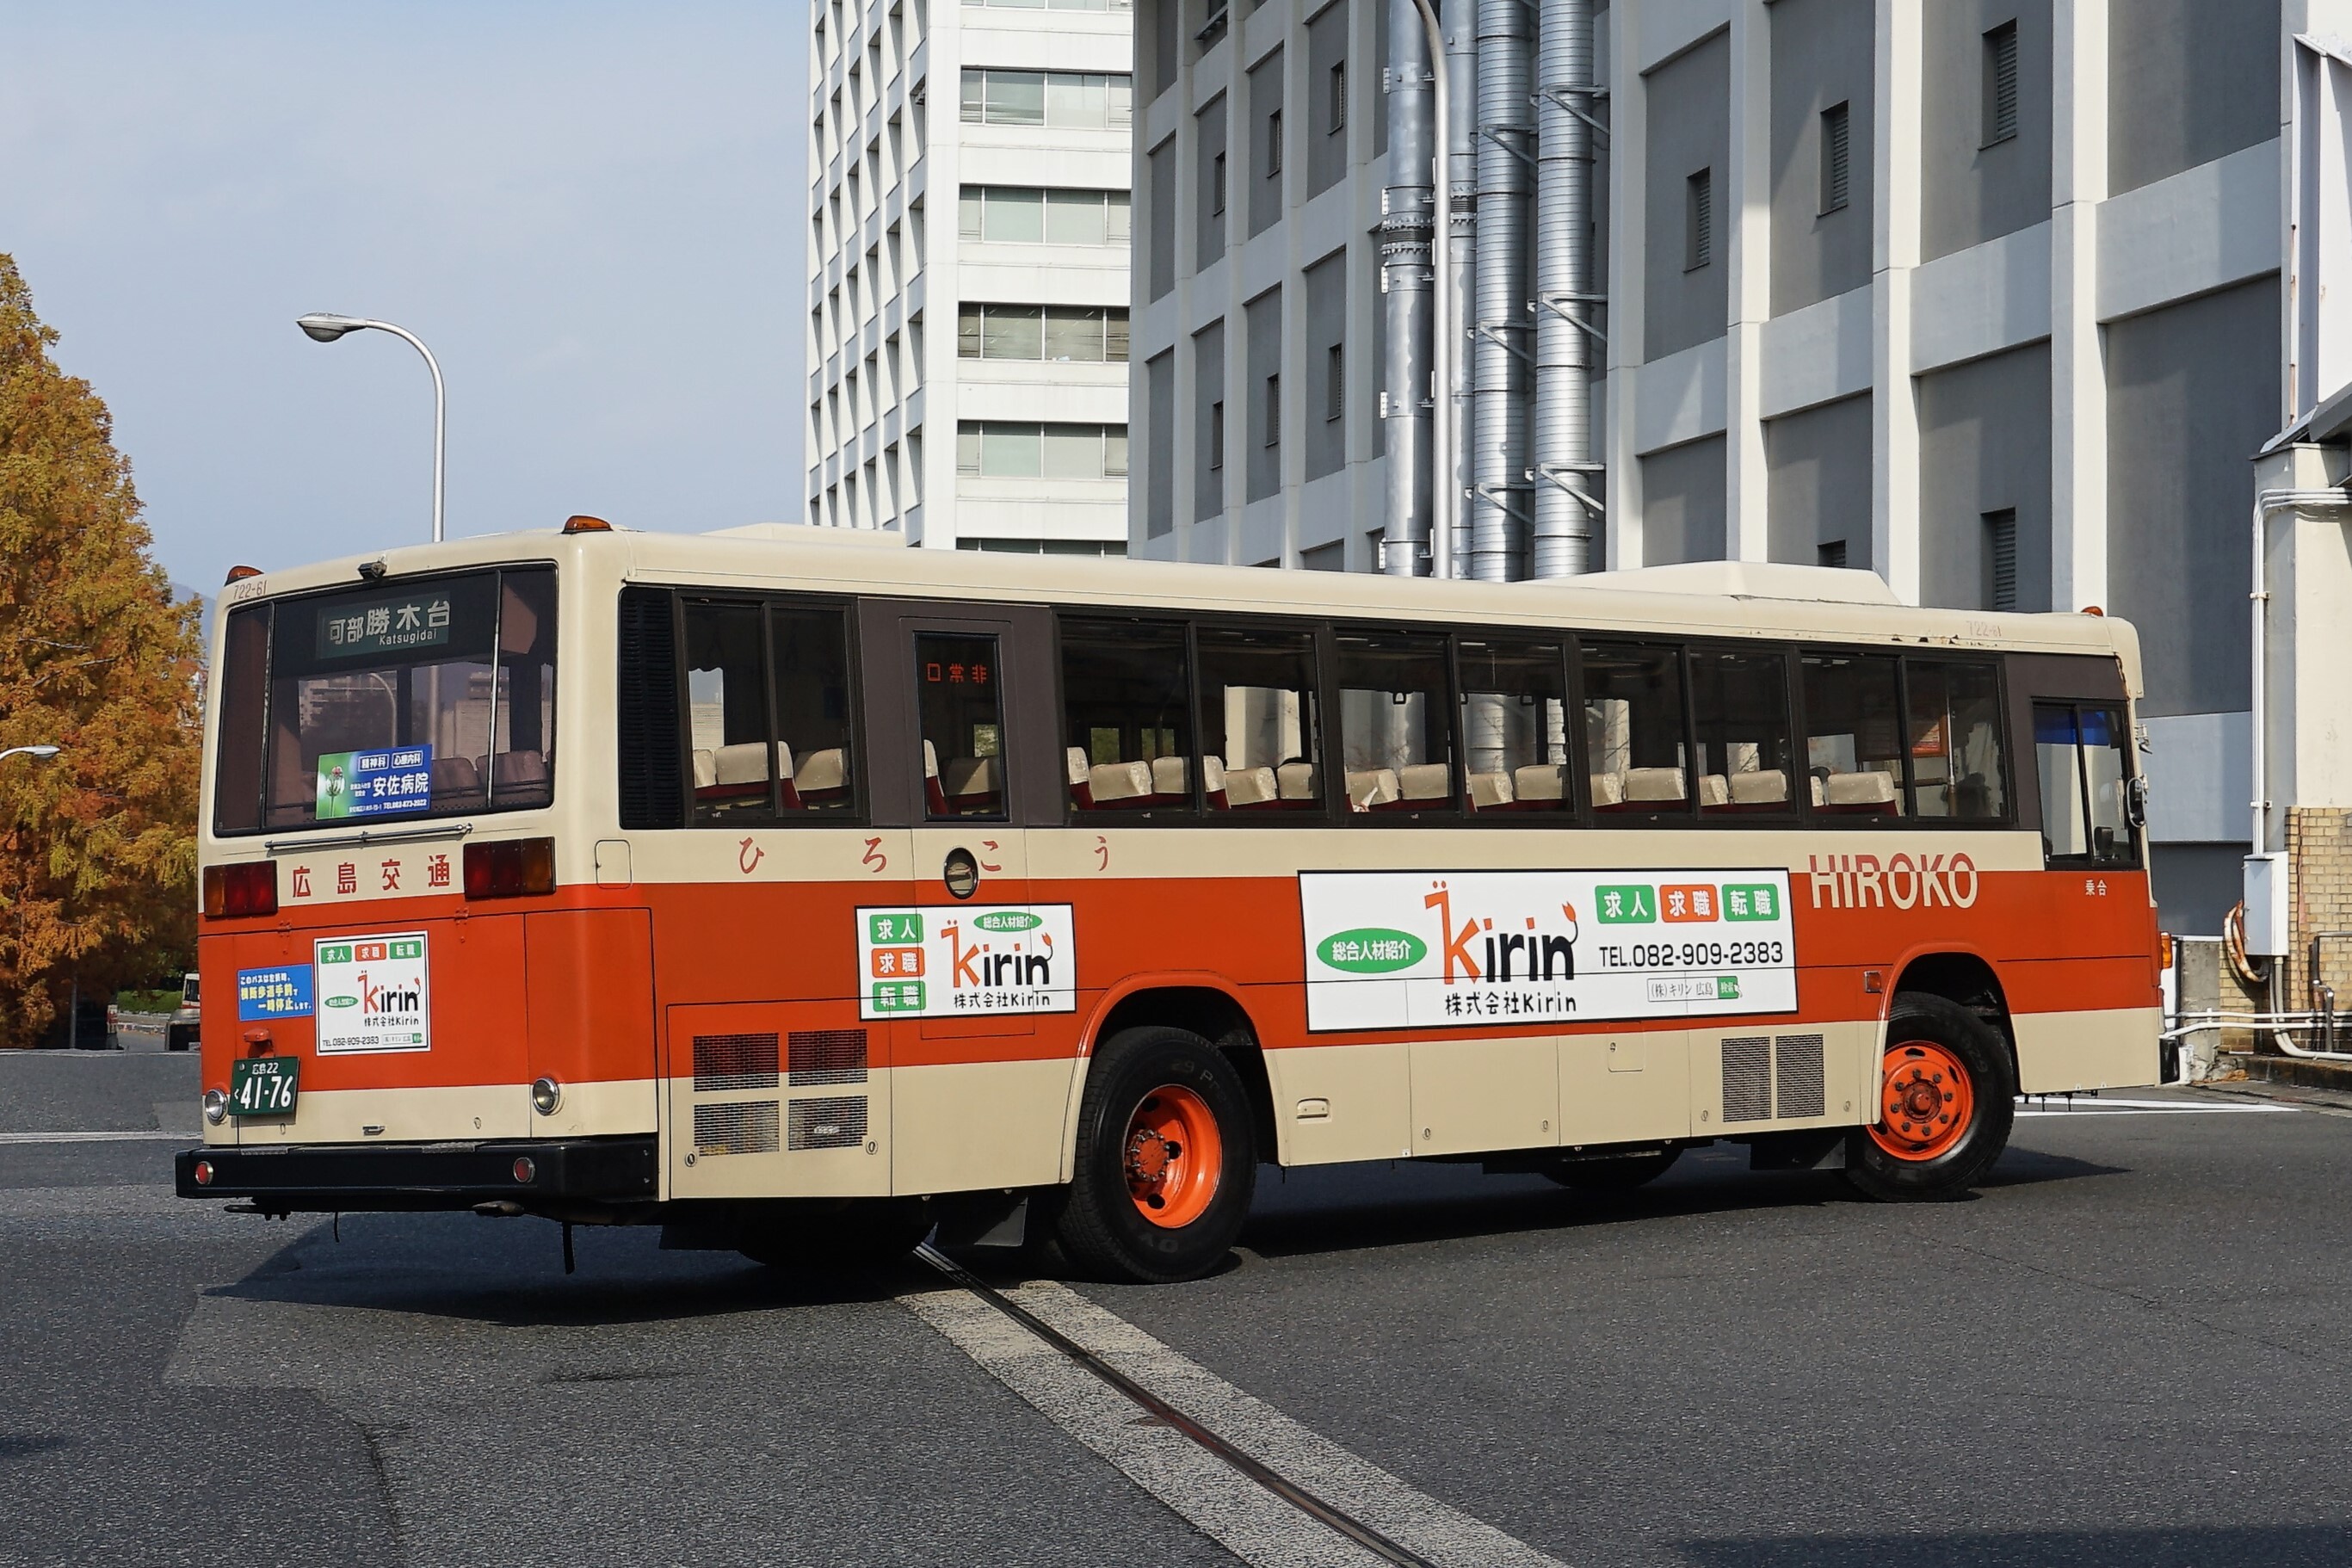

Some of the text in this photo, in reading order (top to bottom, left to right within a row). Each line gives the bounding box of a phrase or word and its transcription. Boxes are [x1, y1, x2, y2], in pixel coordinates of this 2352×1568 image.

[233, 580, 267, 600] 722-61
[379, 628, 437, 645] Katsugidai
[373, 772, 429, 798] 安佐病院
[293, 854, 450, 898] 広島交通
[1809, 852, 1978, 910] HIROKO
[2085, 879, 2108, 896] 乗合
[1603, 891, 1648, 918] 求人
[1668, 890, 1711, 917] 求職
[1730, 890, 1772, 917] 転職
[877, 919, 917, 940] 求人
[1331, 940, 1411, 962] 総合人材紹介
[879, 952, 918, 973] 求職
[880, 985, 920, 1007] 転職
[954, 991, 1051, 1009] 株式会社Kirin
[1445, 991, 1577, 1016] 株式会社Kirin
